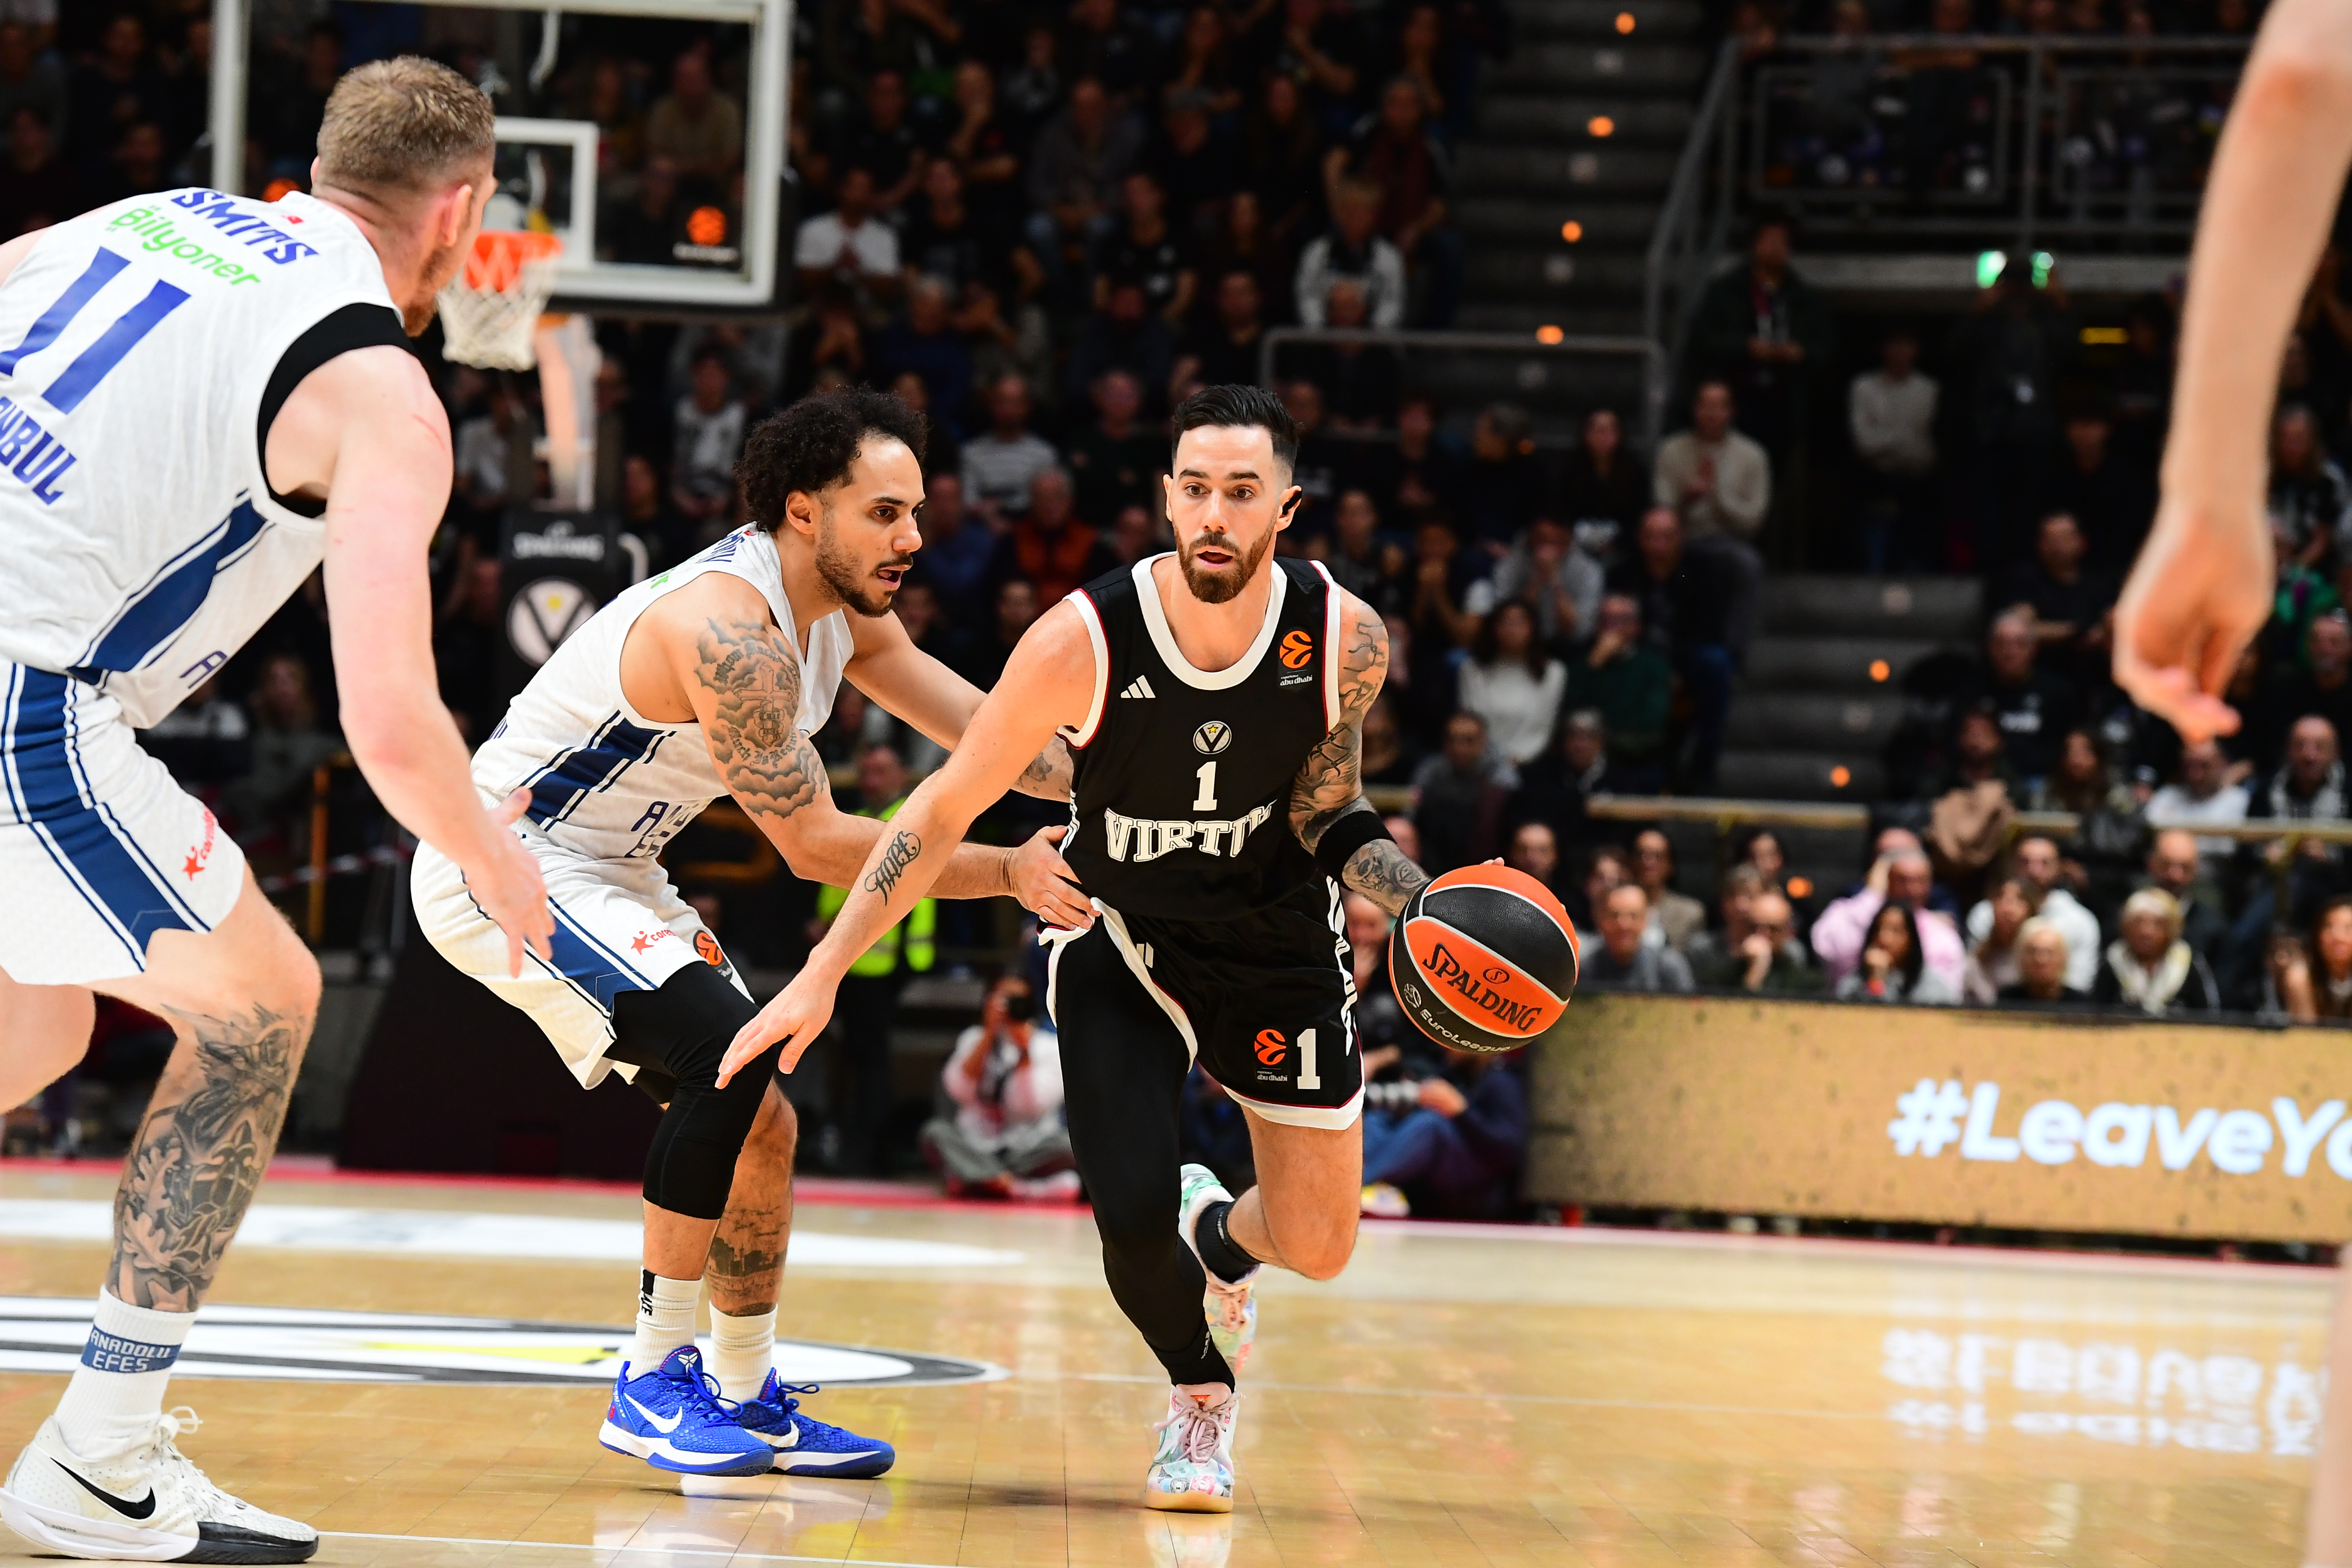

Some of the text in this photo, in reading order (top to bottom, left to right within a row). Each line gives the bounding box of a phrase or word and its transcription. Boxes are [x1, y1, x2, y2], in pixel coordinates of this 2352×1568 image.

[110, 206, 261, 285] Bilyoner
[171, 191, 319, 264] SMITS
[0, 246, 192, 416] 11
[1294, 674, 1313, 684] dhabi
[1192, 761, 1217, 811] 1
[1422, 943, 1543, 1032] SPALDING
[1419, 1008, 1511, 1053] EuroLeague
[1297, 1028, 1320, 1089] 1
[90, 1329, 171, 1359] ANADOLU
[92, 1349, 150, 1372] EFES
